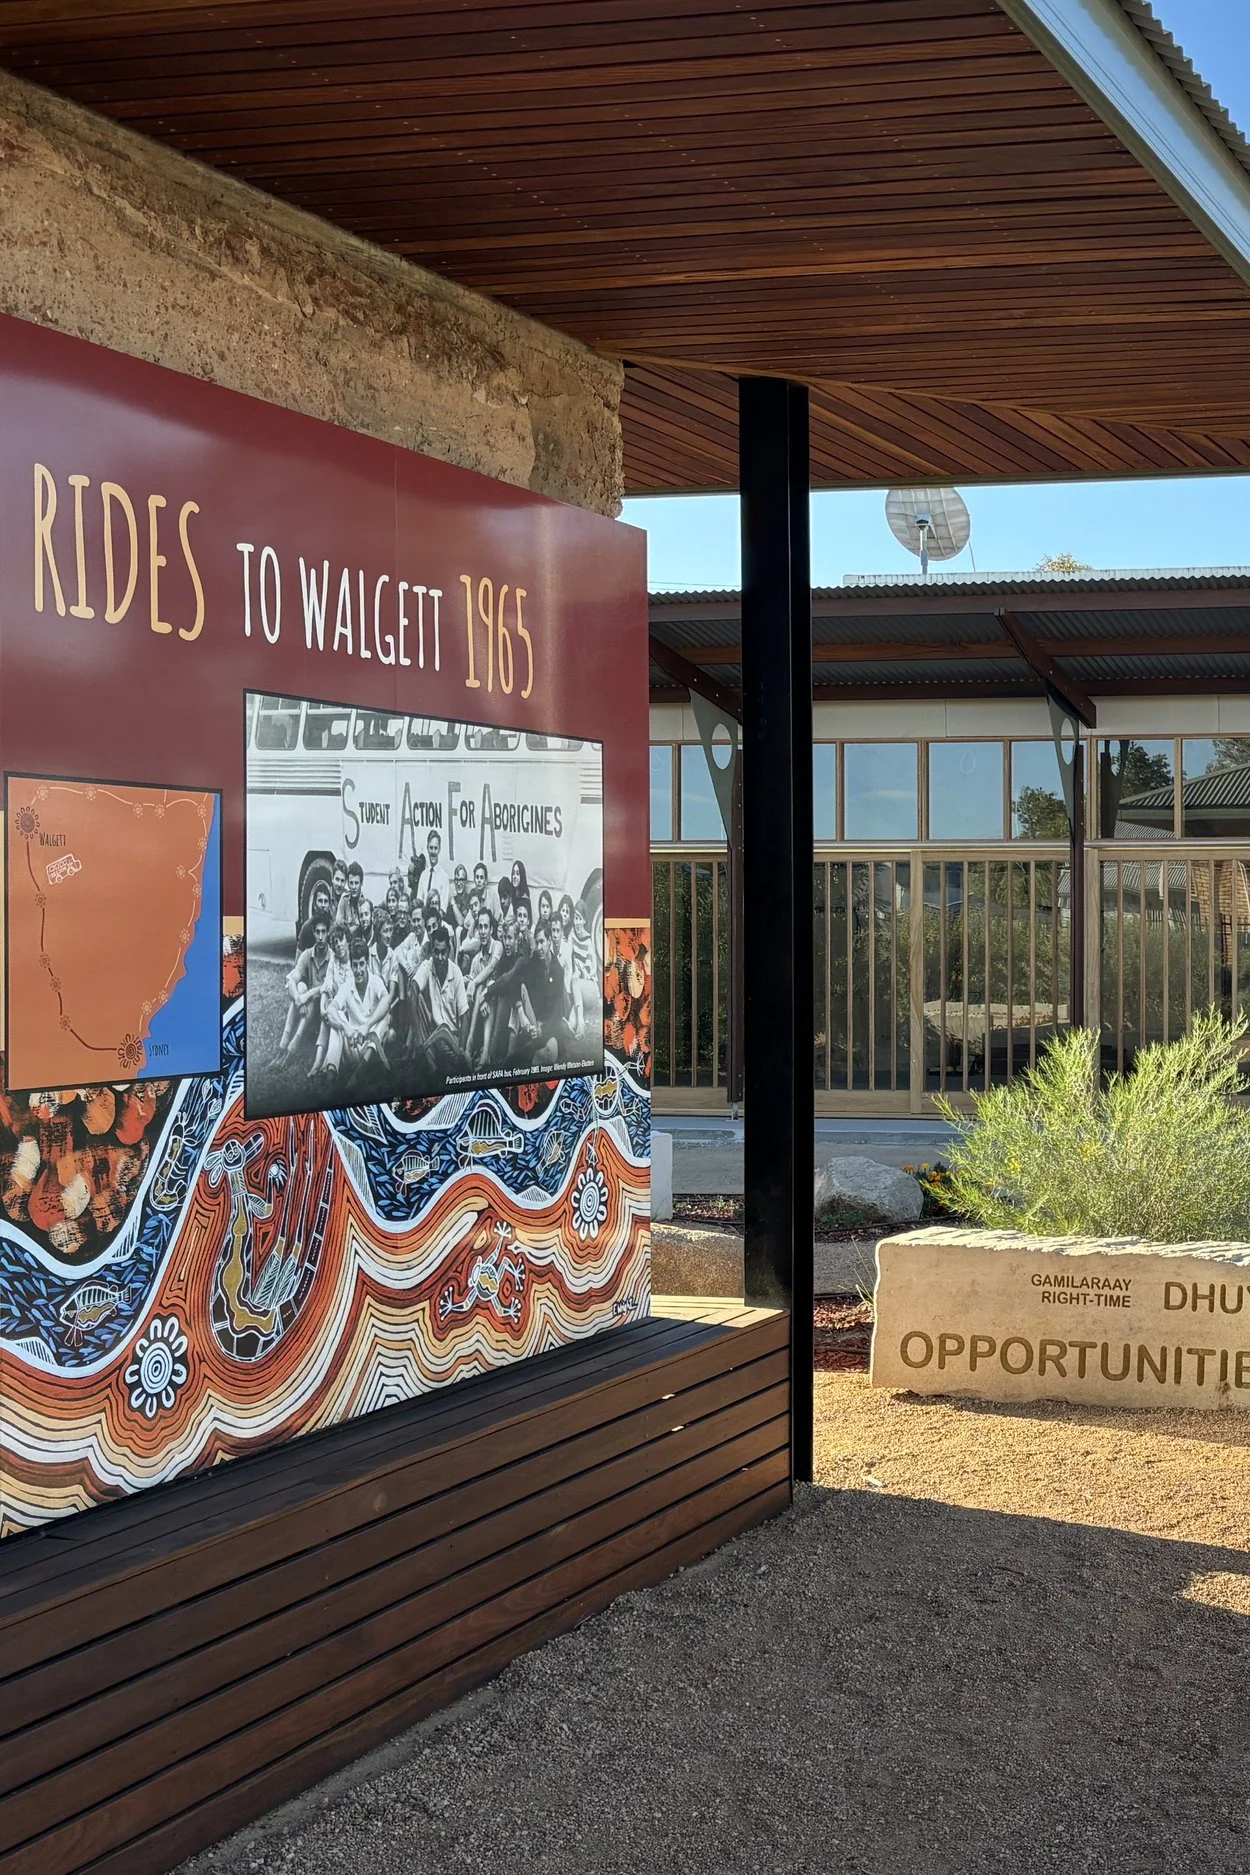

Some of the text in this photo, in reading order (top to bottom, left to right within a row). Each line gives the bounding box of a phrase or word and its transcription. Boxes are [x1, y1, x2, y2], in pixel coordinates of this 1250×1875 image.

[33, 462, 534, 699] RIDES TO WALGETT 1965
[398, 781, 443, 860] ACTION
[447, 781, 476, 862] FOR
[479, 783, 563, 863] ABORIGINES
[1031, 1273, 1133, 1292] GAMILARAAY
[1041, 1291, 1132, 1308] RIGHT-TIME
